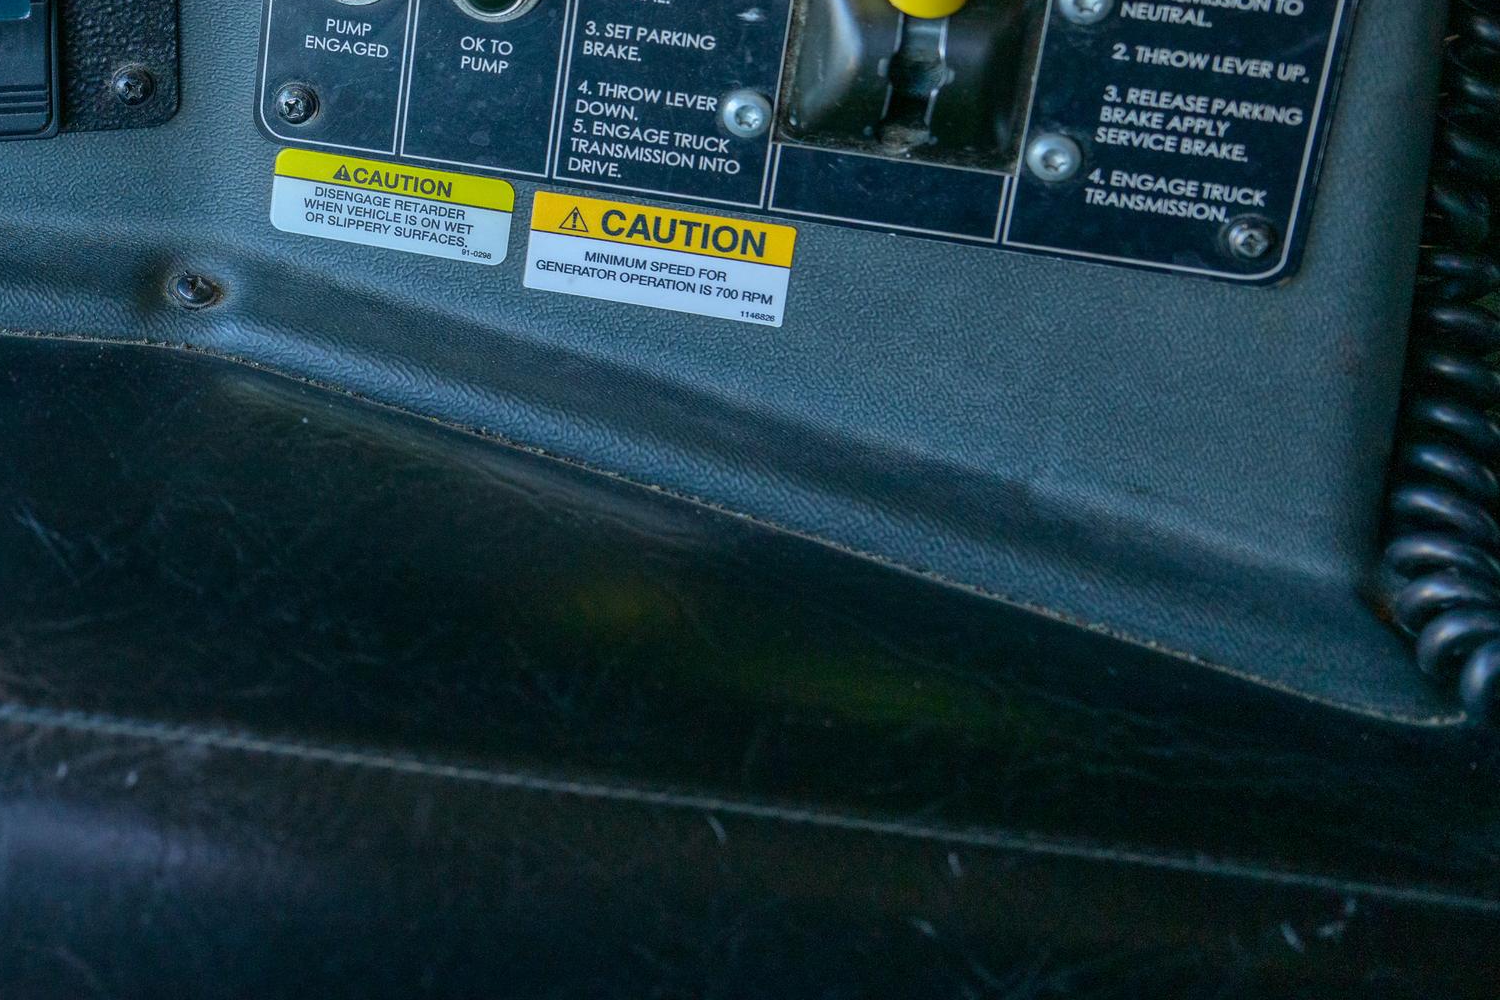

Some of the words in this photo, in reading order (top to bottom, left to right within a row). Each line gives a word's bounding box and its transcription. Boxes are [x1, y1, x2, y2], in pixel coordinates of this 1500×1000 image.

[325, 18, 372, 37] PUMP
[1120, 2, 1213, 28] NEUTRAL.
[304, 35, 389, 59] ENGAGED
[460, 36, 486, 53] OK
[491, 39, 514, 56] TO
[583, 40, 642, 62] BRAKE.
[585, 20, 600, 36] 3.
[604, 23, 633, 41] SET
[636, 27, 716, 51] PARKING
[460, 56, 509, 74] PUMP
[1111, 42, 1130, 62] 2.
[1134, 45, 1211, 72] THROW
[1212, 55, 1274, 79] LEVER
[1276, 62, 1310, 84] UP.
[575, 99, 639, 121] DOWN.
[577, 80, 592, 96] 4.
[597, 82, 662, 105] THROW
[665, 91, 718, 112] LEVER
[1103, 85, 1122, 103] 3.
[1126, 87, 1209, 114] RELEASE
[1210, 99, 1304, 127] PARKING
[572, 119, 587, 135] 5.
[592, 122, 669, 146] ENGAGE
[674, 133, 730, 154] TRUCK
[1100, 105, 1165, 130] BRAKE
[1166, 115, 1231, 139] APPLY
[570, 137, 695, 169] TRANSMISSION
[698, 157, 740, 175] INTO
[1094, 126, 1178, 153] SERVICE
[1180, 139, 1249, 163] BRAKE.
[352, 167, 453, 198] CAUTION
[568, 158, 621, 178] DRIVE.
[314, 186, 392, 208] DISENGAGE
[394, 199, 466, 221] RETARDER
[1087, 168, 1105, 186] 4.
[1109, 170, 1200, 198] ENGAGE
[1202, 183, 1268, 208] TRUCK
[303, 198, 345, 214] WHEN
[347, 204, 401, 223] VEHICLE
[405, 215, 417, 226] IS
[421, 217, 441, 230] ON
[444, 221, 474, 236] WET
[1084, 187, 1230, 224] TRANSMISSION.
[305, 211, 324, 224] OR
[327, 215, 391, 235] SLIPPERY
[394, 226, 469, 249] SURFACES.
[600, 209, 767, 258] CAUTION
[461, 248, 492, 260] 91-0298
[584, 251, 647, 270] MINIMUM
[650, 261, 696, 278] SPEED
[698, 268, 727, 283] FOR
[535, 259, 616, 282] GENERATOR
[619, 272, 696, 294] OPERATION
[699, 284, 712, 296] IS
[715, 286, 739, 301] 700
[742, 291, 773, 306] RPM
